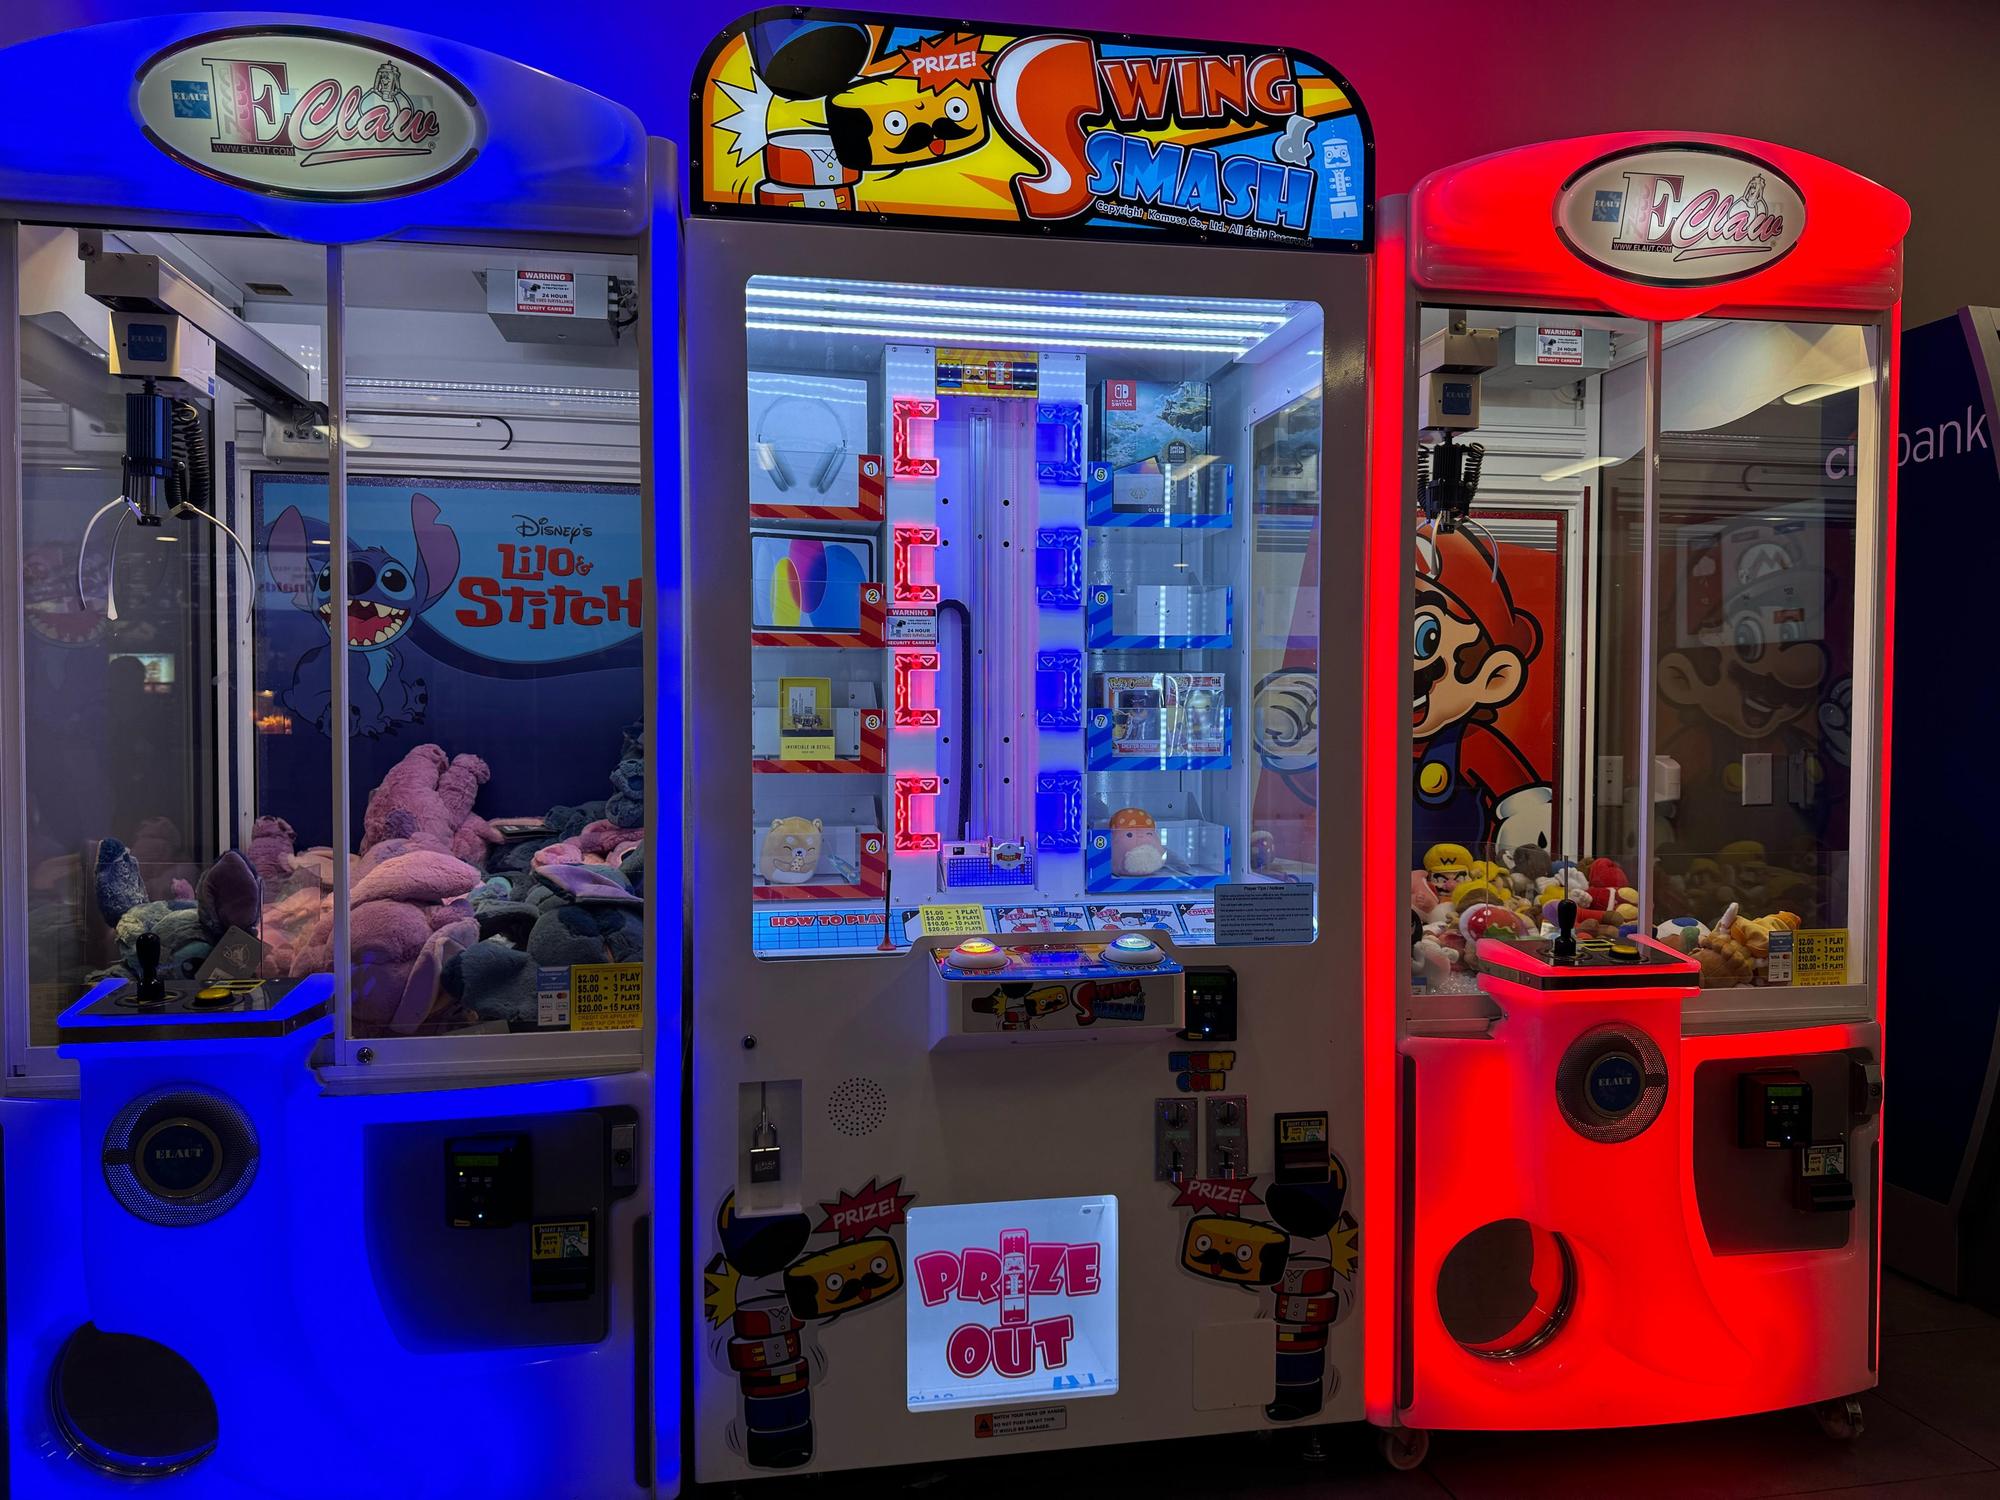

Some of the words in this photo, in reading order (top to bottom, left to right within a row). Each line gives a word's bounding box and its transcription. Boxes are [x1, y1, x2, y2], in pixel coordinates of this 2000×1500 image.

[912, 51, 976, 75] PRIZE!
[173, 91, 209, 102] ELAUT
[213, 144, 295, 156] WWW.ELAUT.COM
[1085, 131, 1318, 230] SMASH
[1095, 200, 1144, 218] Copyright
[1148, 209, 1187, 226] Komuse
[1229, 224, 1244, 236] All
[1245, 227, 1268, 242] right
[1613, 243, 1673, 253] WWW.ELAUT.COM
[525, 272, 566, 281] WARNING
[770, 915, 816, 927] HOW
[818, 915, 843, 926] TO
[845, 913, 891, 925] PLAY
[577, 974, 599, 983] $2.00
[620, 973, 640, 981] PLAY
[577, 984, 599, 993] $5.00
[620, 984, 640, 992] PLAYS
[577, 994, 602, 1002] $10.00
[577, 1004, 602, 1012] $20.00
[1598, 1077, 1633, 1086] ELAUT
[155, 1148, 204, 1159] ELAUT
[1187, 1180, 1247, 1203] PRIZE!
[832, 1197, 895, 1230] PRIZE!
[914, 1229, 1101, 1325] PRIZE
[946, 1314, 1074, 1378] OUT
